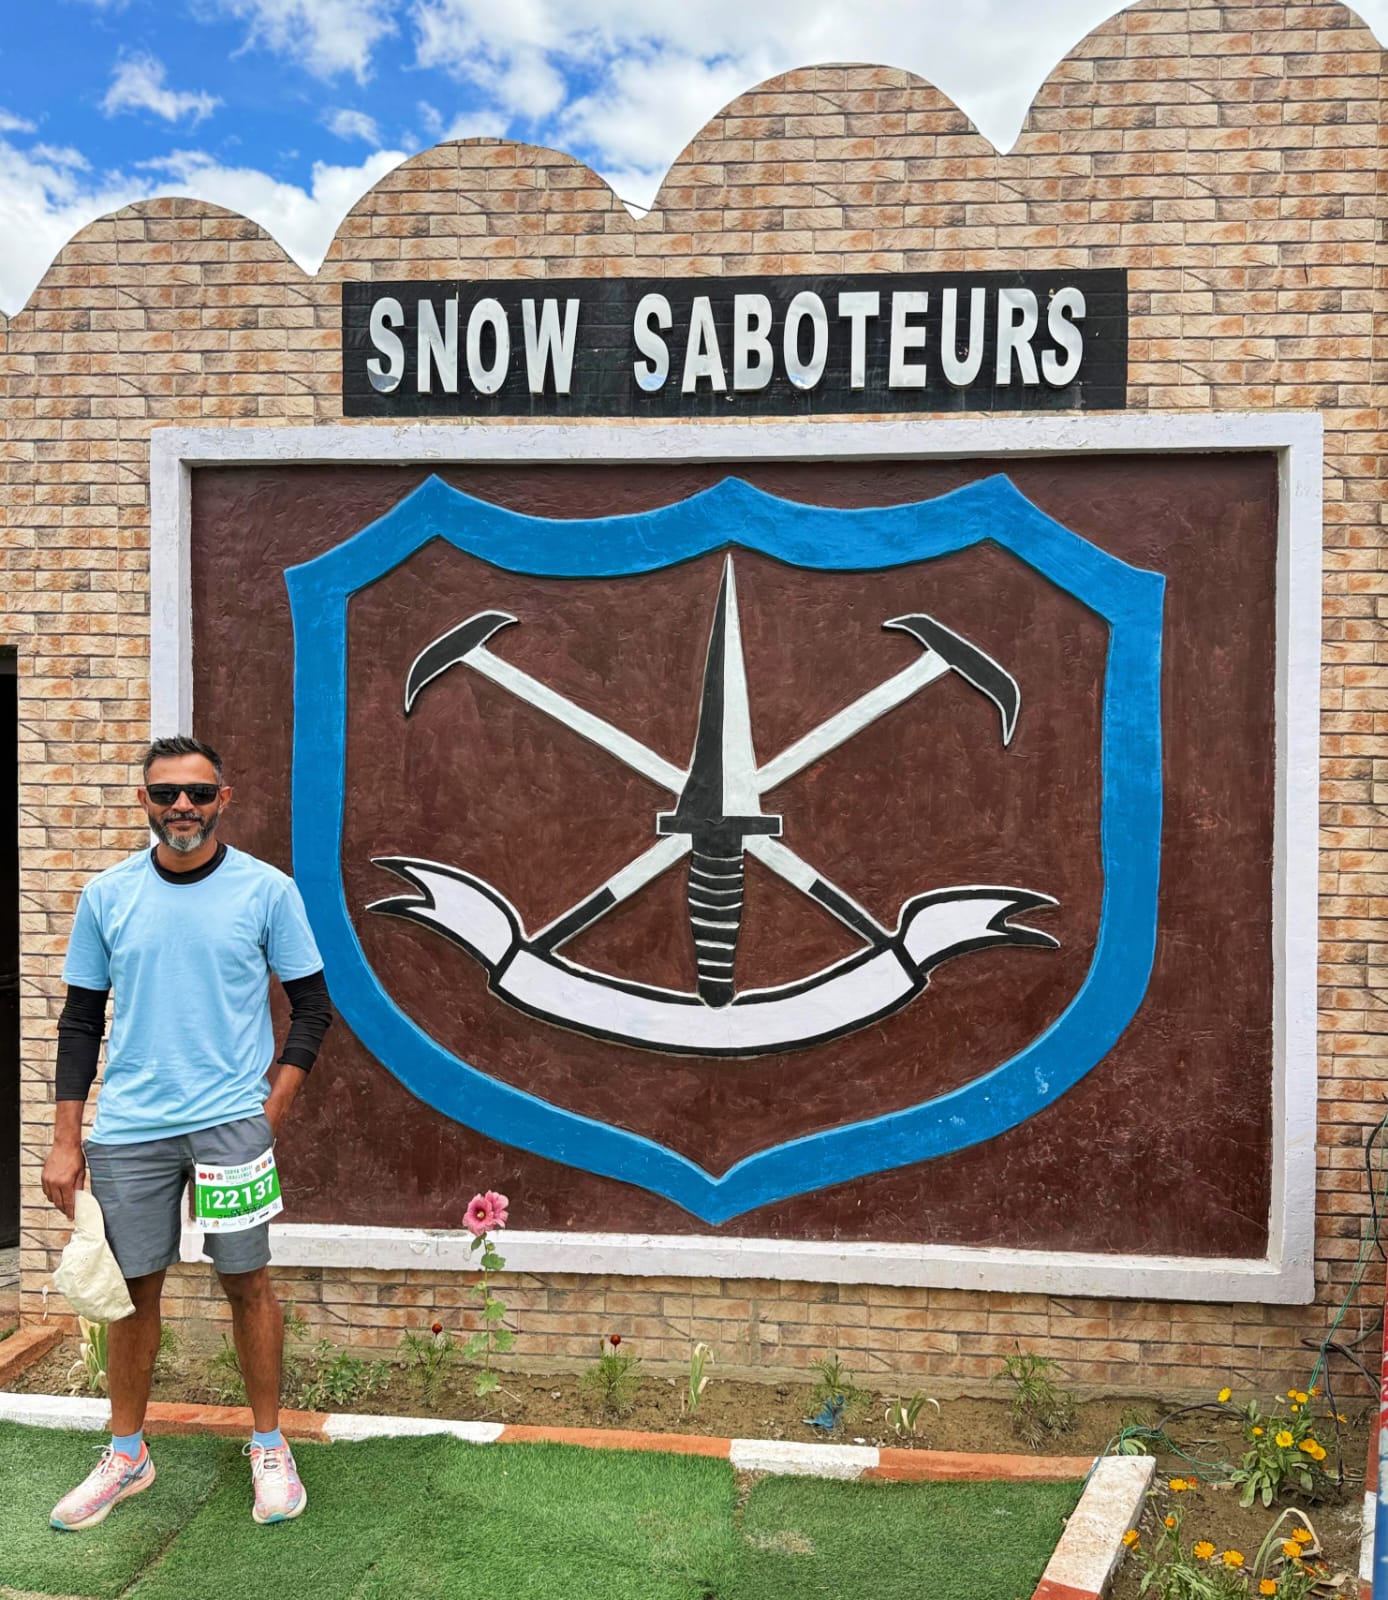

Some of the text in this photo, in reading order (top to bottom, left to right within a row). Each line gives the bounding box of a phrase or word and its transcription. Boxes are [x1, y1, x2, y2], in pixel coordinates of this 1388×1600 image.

[366, 287, 1086, 395] SNOW SABOTEURS
[212, 1173, 274, 1209] 22137
